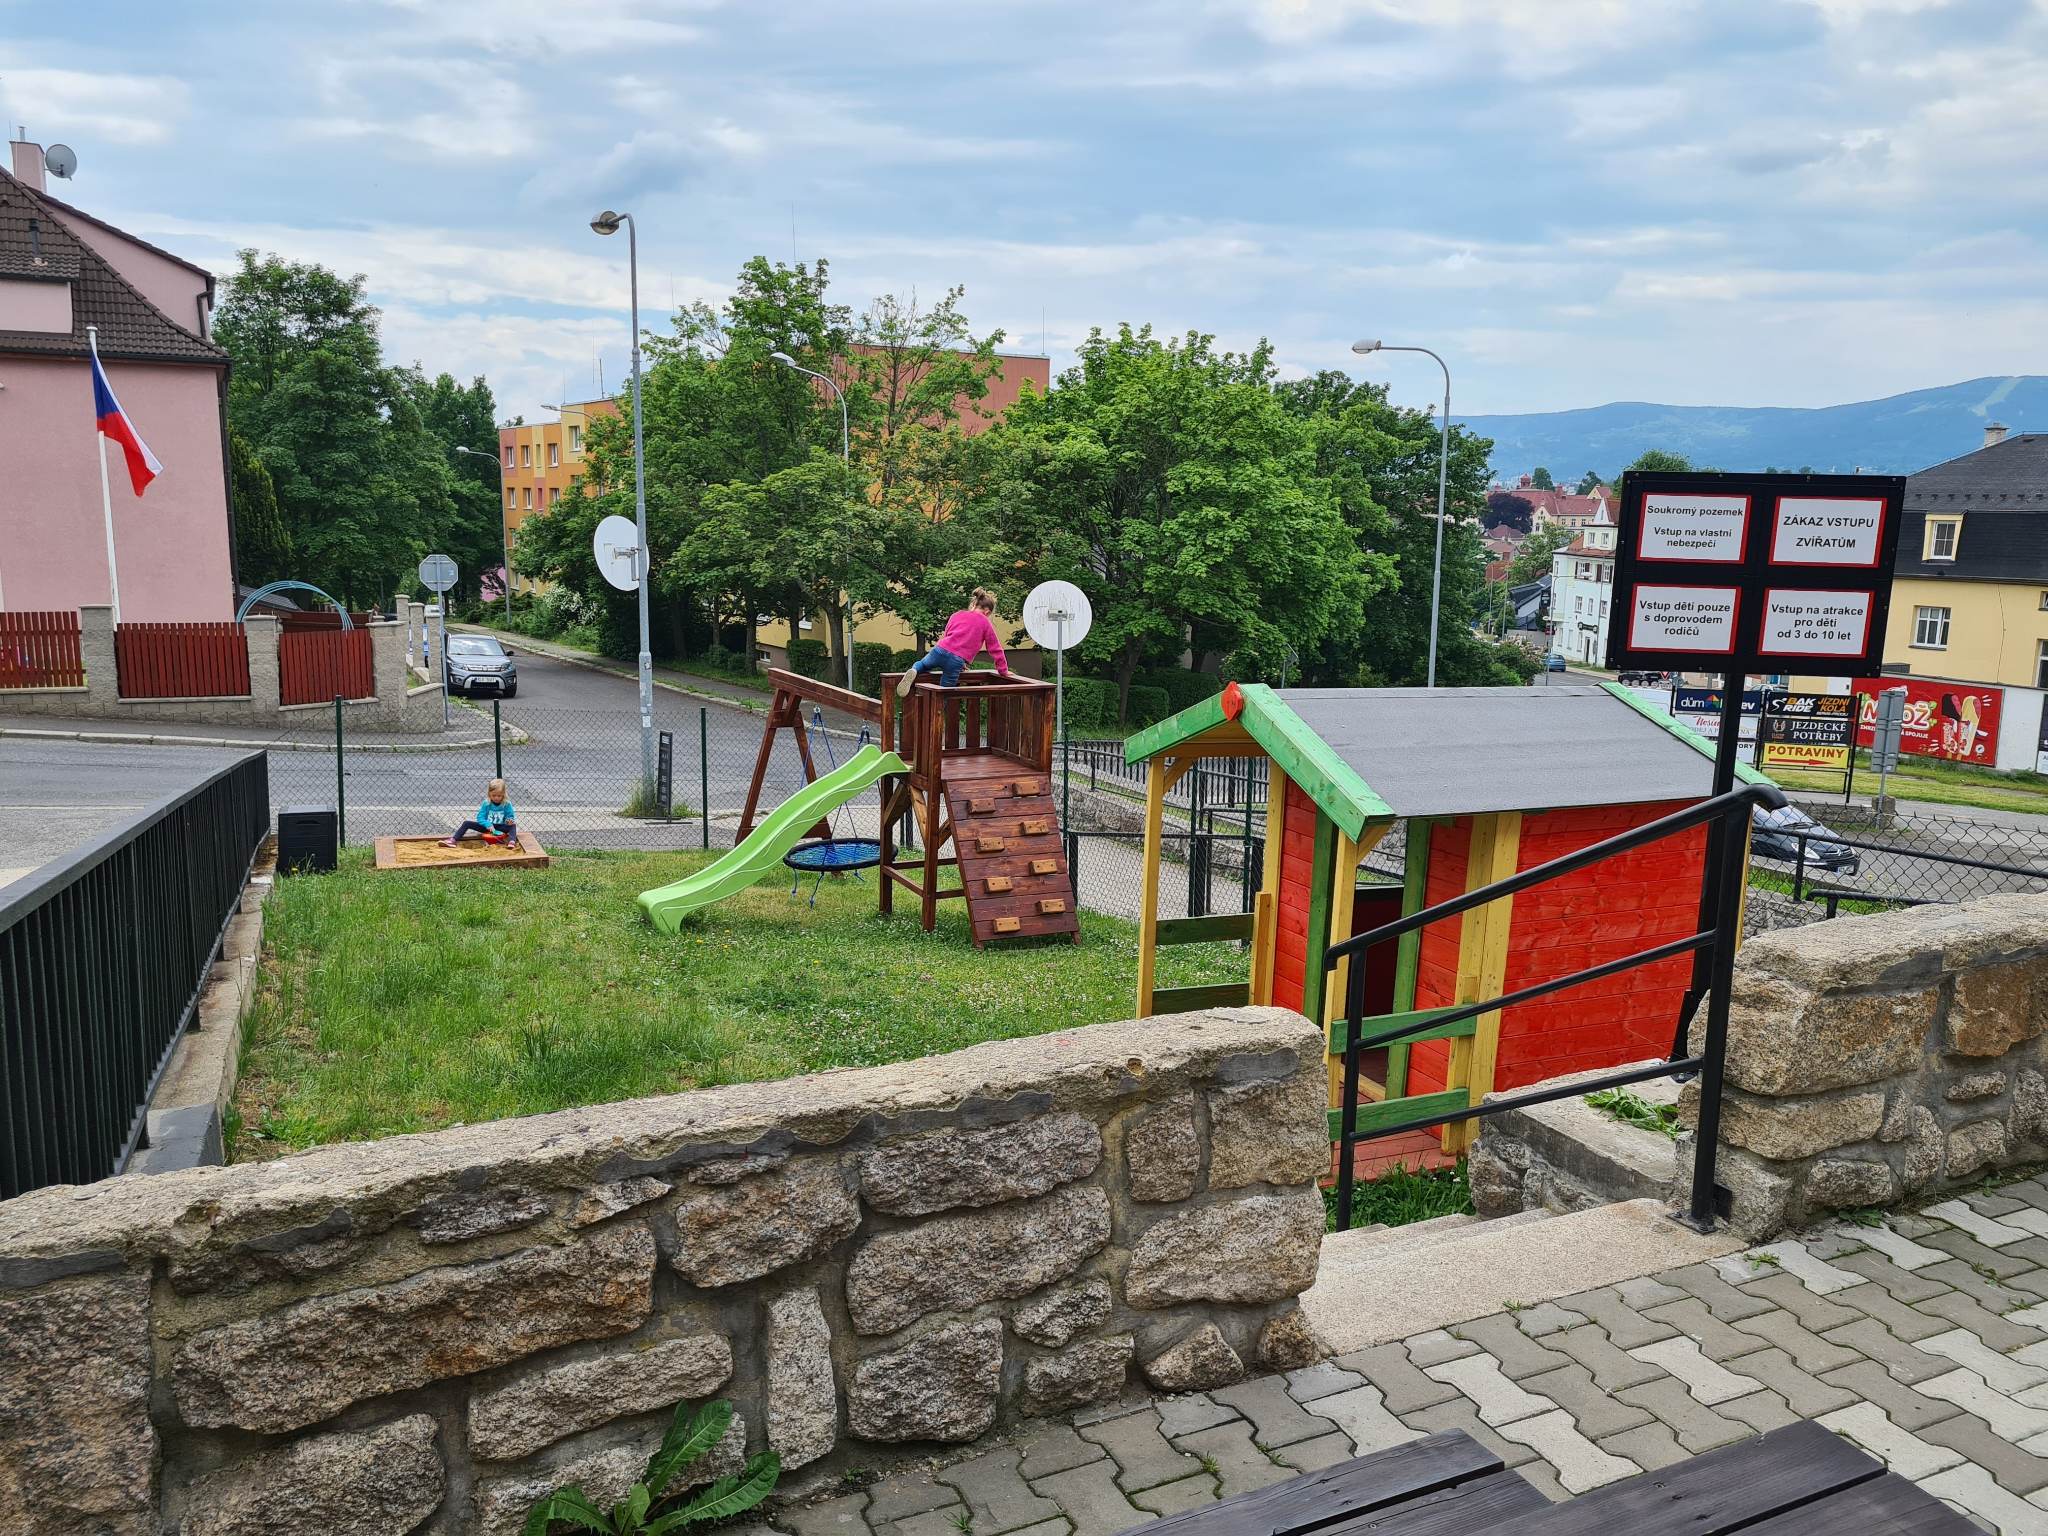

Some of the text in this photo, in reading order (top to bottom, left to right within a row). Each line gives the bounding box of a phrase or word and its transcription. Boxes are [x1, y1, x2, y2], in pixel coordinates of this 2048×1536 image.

[1647, 505, 1743, 517] Soukromý pozemek
[1783, 514, 1874, 528] ZÁKAZ VSTUPU
[1654, 527, 1682, 537] Vstup
[1699, 528, 1733, 537] vlastní
[1667, 539, 1716, 549] nebezpečí
[1796, 535, 1856, 548] ZVÍŘATŮM
[1639, 600, 1671, 612] Vstup
[1697, 604, 1731, 613] pouze
[1771, 604, 1864, 616] Vstup na atrakce
[1644, 613, 1723, 624] s doprovodem
[1794, 617, 1838, 628] pro děti
[1664, 626, 1700, 636] rodičů
[1777, 629, 1851, 641] od 3 do 10 let
[1783, 704, 1846, 713] RIDE KOLA
[1862, 701, 1930, 729] MOŽ
[1790, 721, 1847, 732] JEZDECKÉ
[1793, 730, 1844, 741] POTŘEBY
[1768, 745, 1846, 758] POTRAVINY
